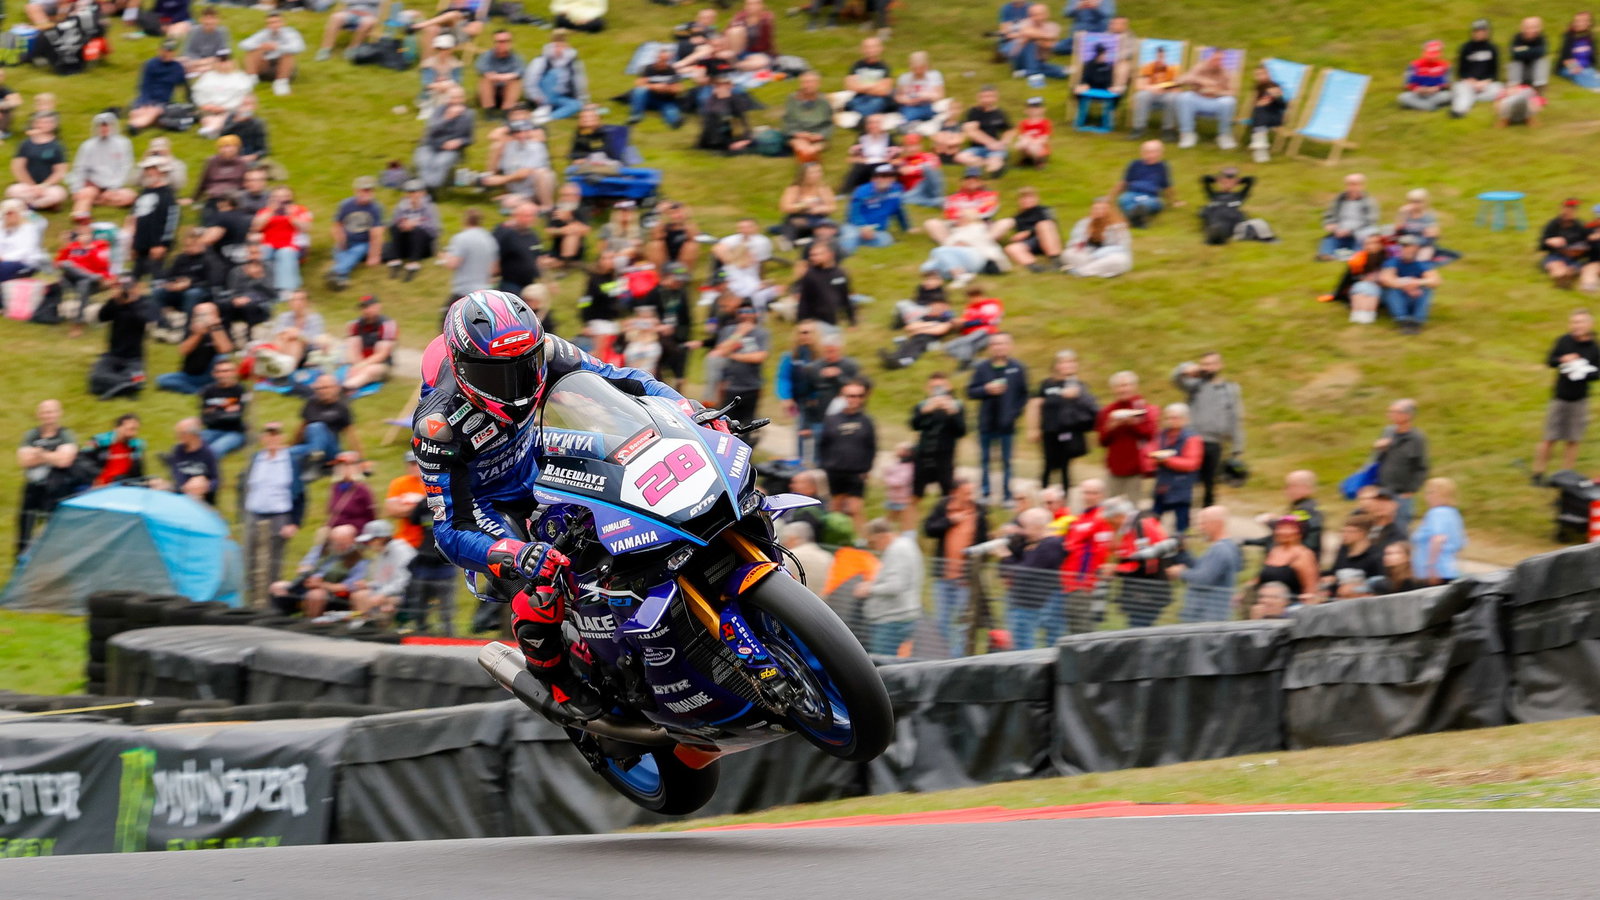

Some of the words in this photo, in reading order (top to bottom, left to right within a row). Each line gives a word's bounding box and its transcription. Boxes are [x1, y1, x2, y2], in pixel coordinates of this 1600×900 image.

[491, 332, 530, 348] LS2
[728, 446, 750, 479] YAMAHA
[543, 463, 608, 486] RACEWAYS
[634, 443, 707, 507] 28
[689, 493, 717, 518] GYTR
[601, 517, 632, 534] YAMALUBE
[609, 530, 659, 554] YAMAHA
[760, 667, 777, 680] sbs
